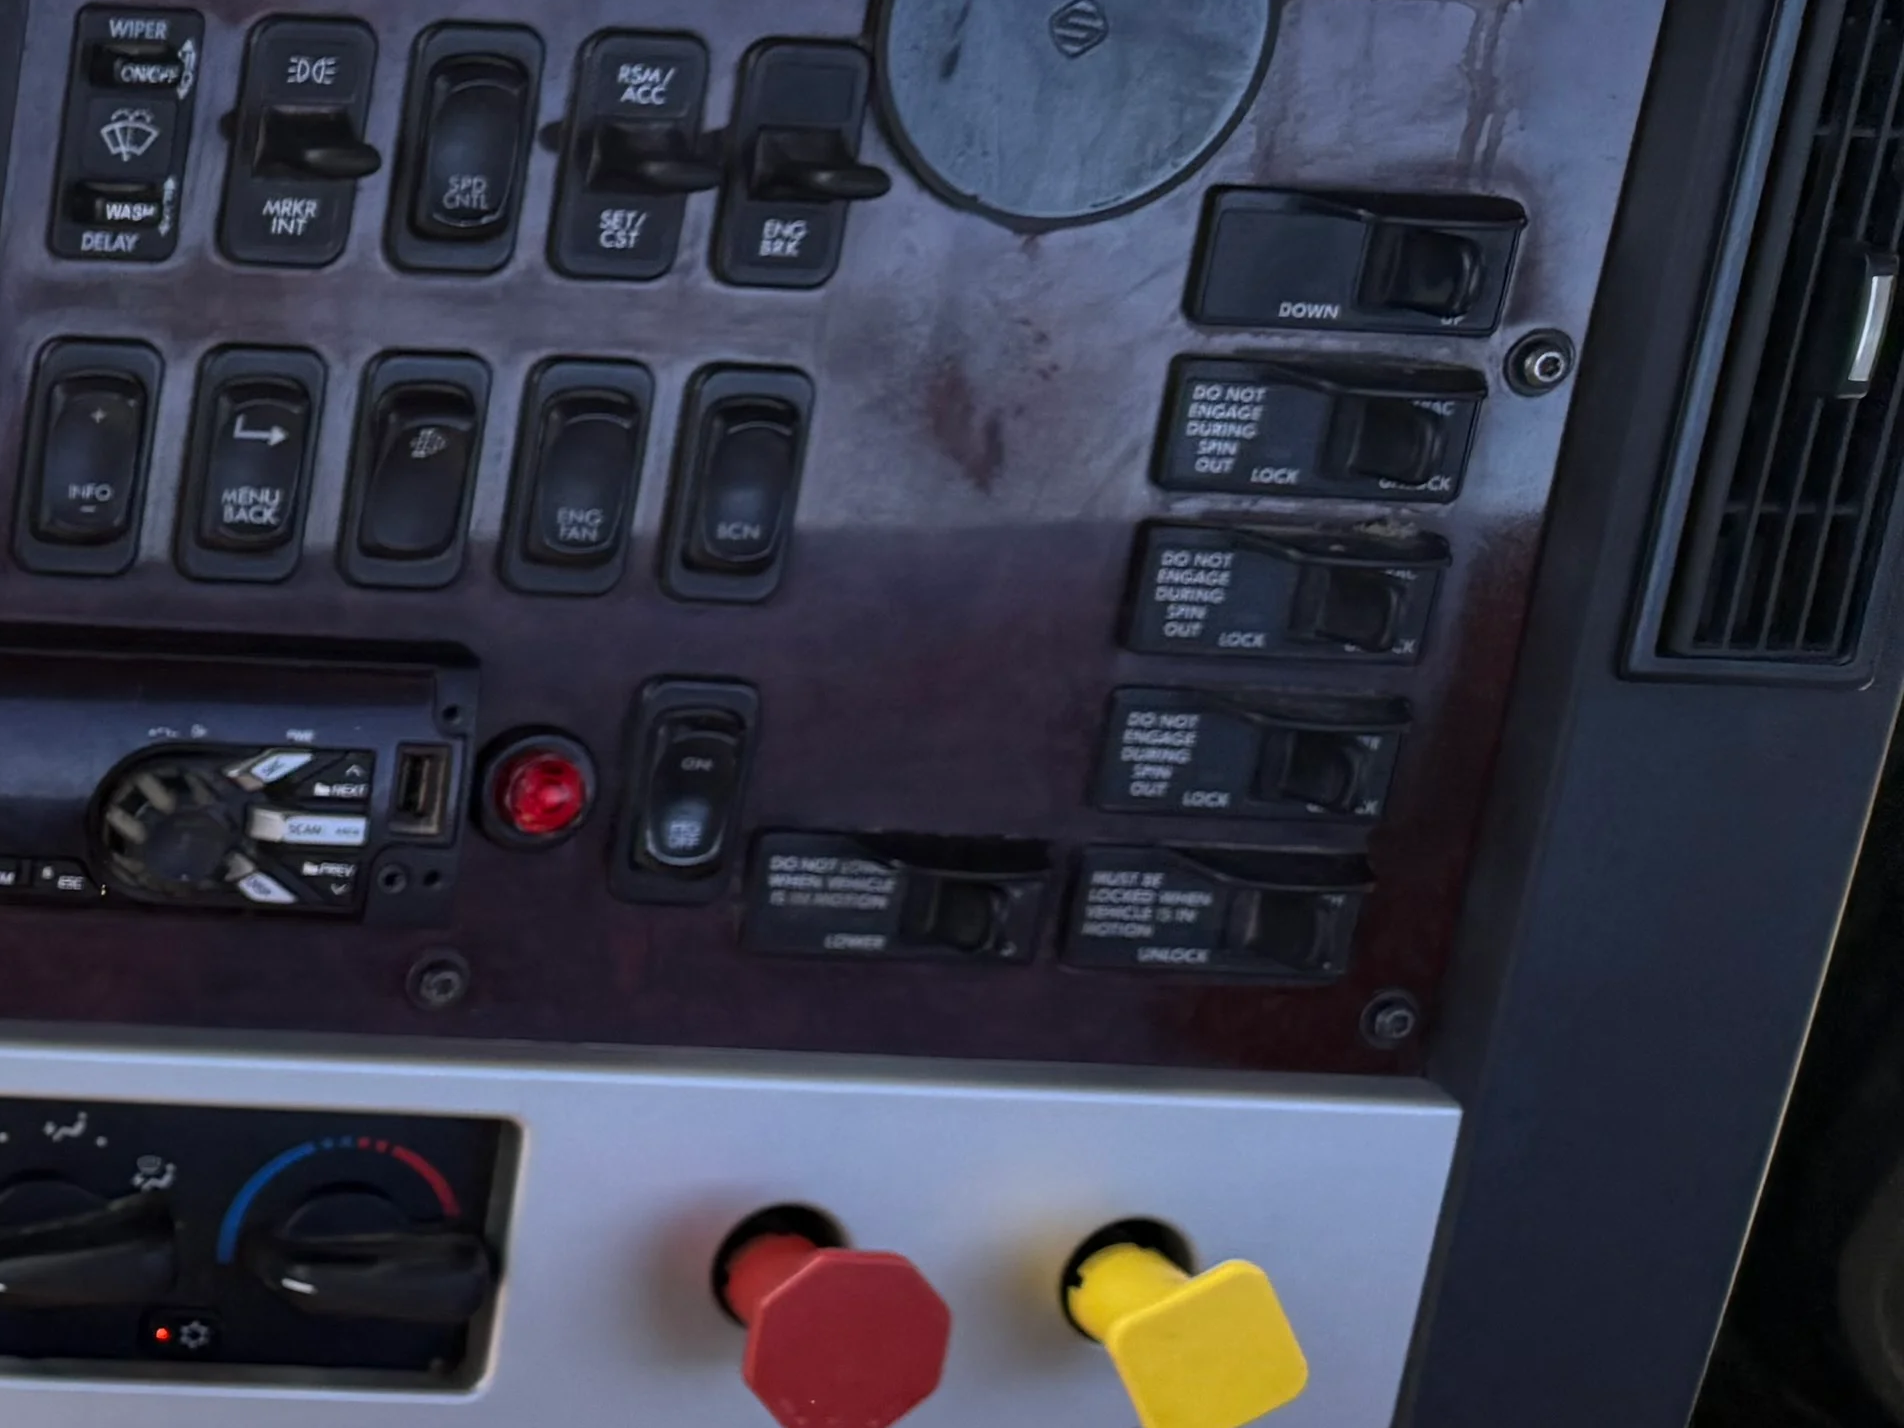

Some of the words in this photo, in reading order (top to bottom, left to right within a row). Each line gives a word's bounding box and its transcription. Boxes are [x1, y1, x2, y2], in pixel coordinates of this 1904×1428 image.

[108, 19, 168, 40] WIPER
[616, 63, 675, 86] RSM/
[619, 85, 669, 106] ACC
[447, 175, 487, 194] SPD
[261, 197, 319, 218] MRKR
[442, 192, 489, 211] CNTL
[105, 201, 157, 222] WASH
[599, 208, 648, 232] SET/
[270, 217, 308, 236] INT
[762, 218, 810, 241] ENG
[80, 231, 140, 252] DELAY
[599, 230, 640, 250] CST
[758, 238, 800, 258] BRK
[1278, 300, 1340, 320] DOWN
[1191, 384, 1222, 402] DO
[1224, 386, 1268, 404] NOT
[1186, 403, 1266, 422] ENGAGE
[1185, 421, 1257, 439] DURING
[1195, 439, 1238, 456] SPIN
[1194, 456, 1236, 474] OUT
[1249, 467, 1300, 485] LOCK
[68, 483, 114, 503] INFO
[221, 486, 281, 507] MENU
[222, 505, 280, 527] BACK
[556, 506, 603, 526] ENG
[558, 524, 599, 543] FAN
[1160, 549, 1189, 568] DO
[1193, 551, 1235, 569] NOT
[1155, 569, 1231, 587] ENGAGE
[1153, 586, 1226, 604] DURING
[1162, 621, 1204, 638] OUT
[1217, 632, 1267, 649] LOCK
[330, 783, 369, 797] NEXT
[1181, 790, 1231, 808] LOCK
[287, 824, 323, 836] SCAN
[318, 862, 357, 877] PREV
